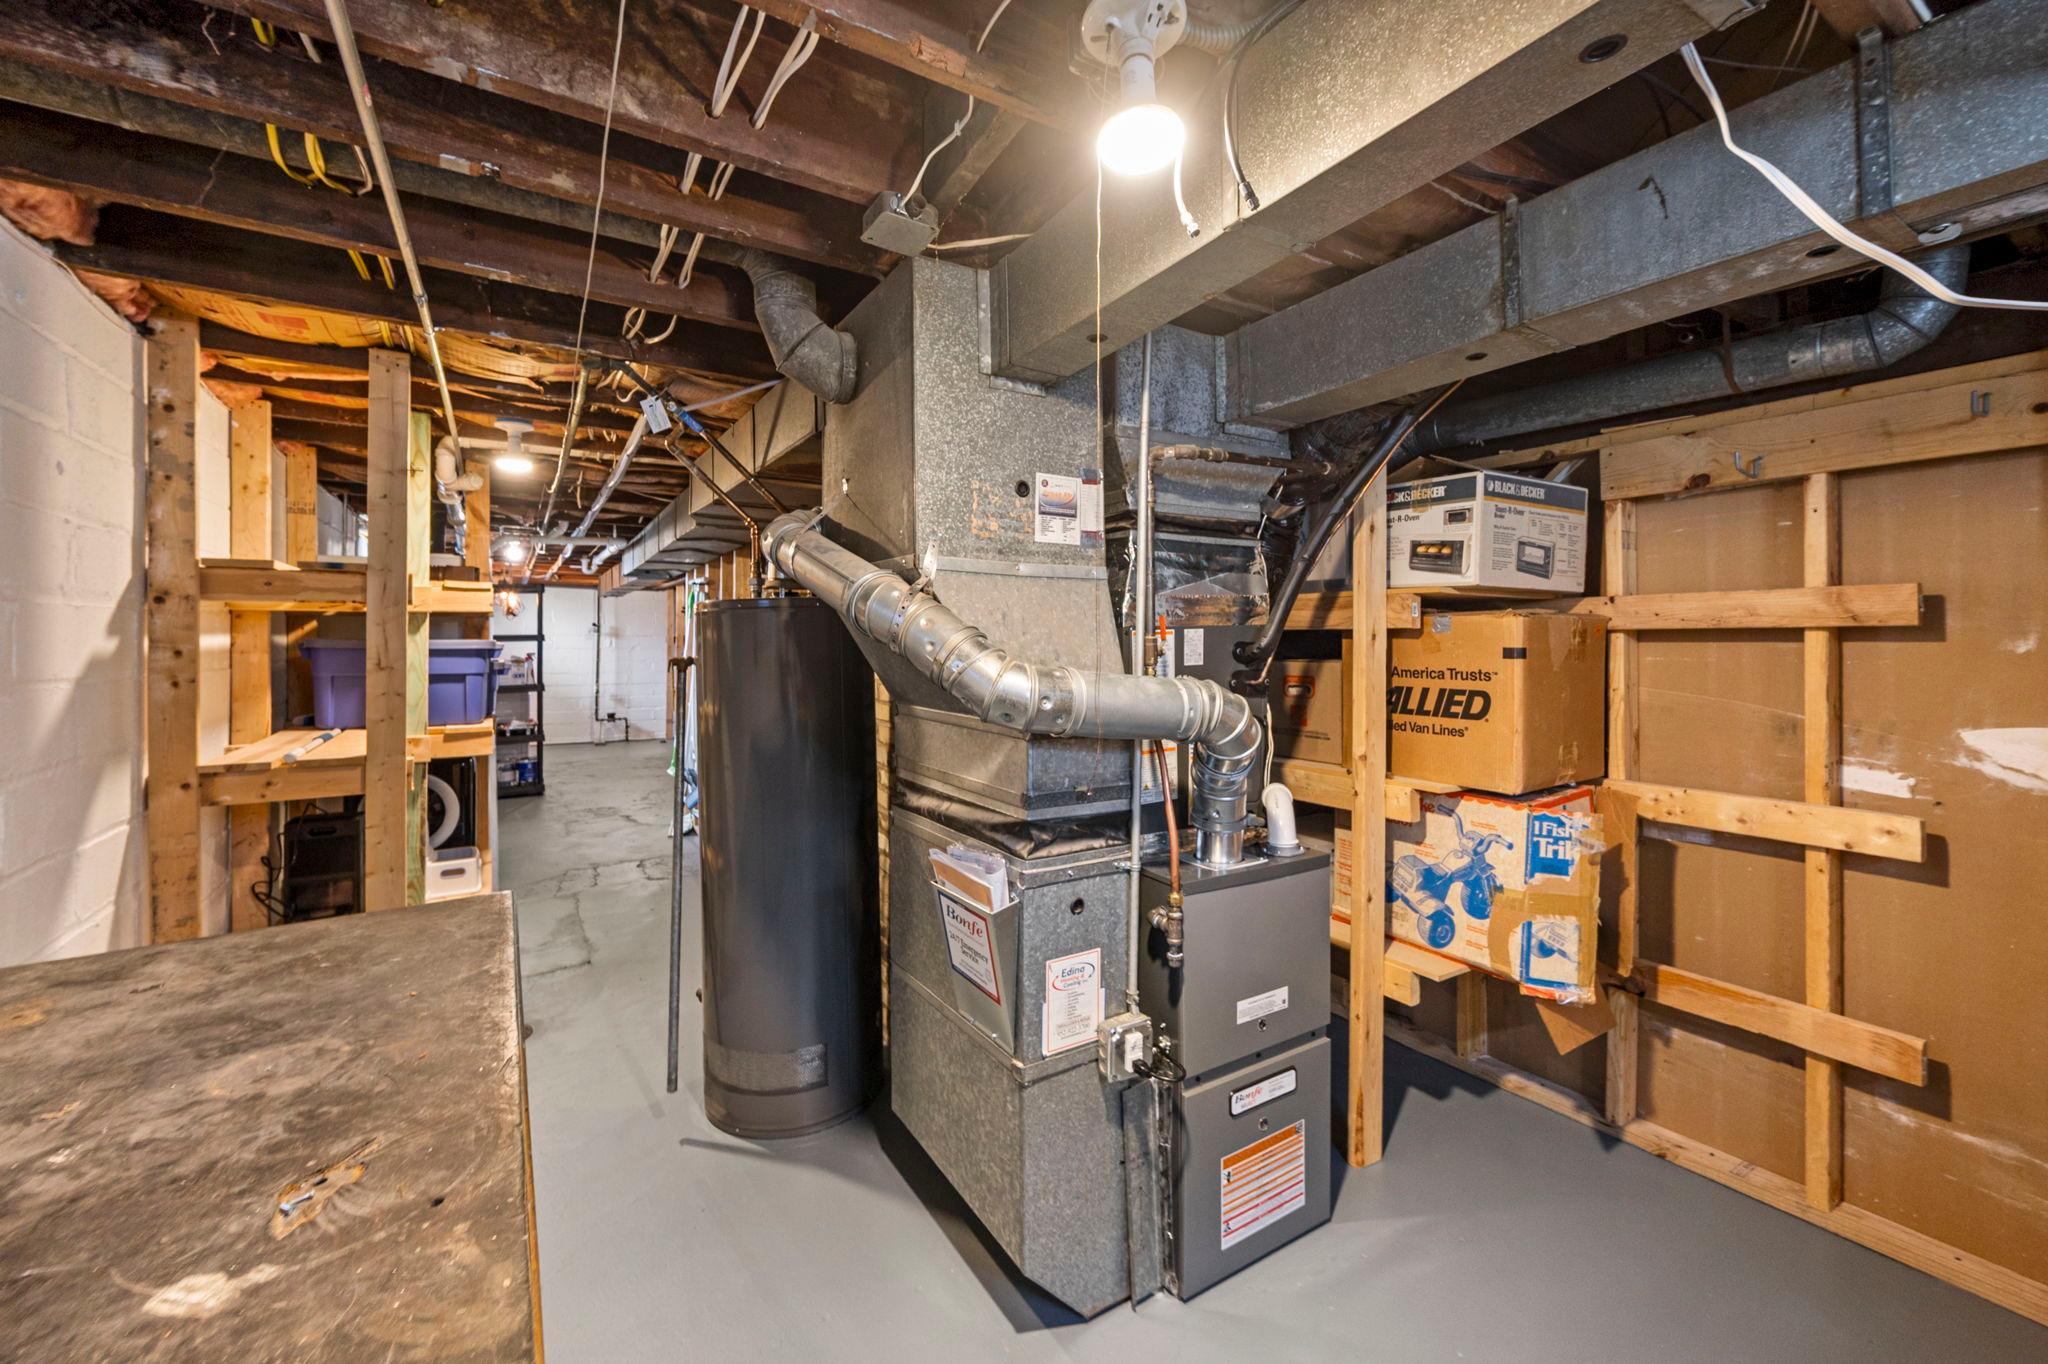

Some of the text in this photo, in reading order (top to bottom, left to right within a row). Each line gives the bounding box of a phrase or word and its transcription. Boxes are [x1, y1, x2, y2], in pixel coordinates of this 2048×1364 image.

[1391, 666, 1492, 682] America Trusts
[1387, 685, 1492, 721] ALLIED
[1409, 721, 1430, 734] Van
[1432, 723, 1465, 738] Lines
[946, 904, 983, 938] Bonfe
[1061, 966, 1085, 978] Edina
